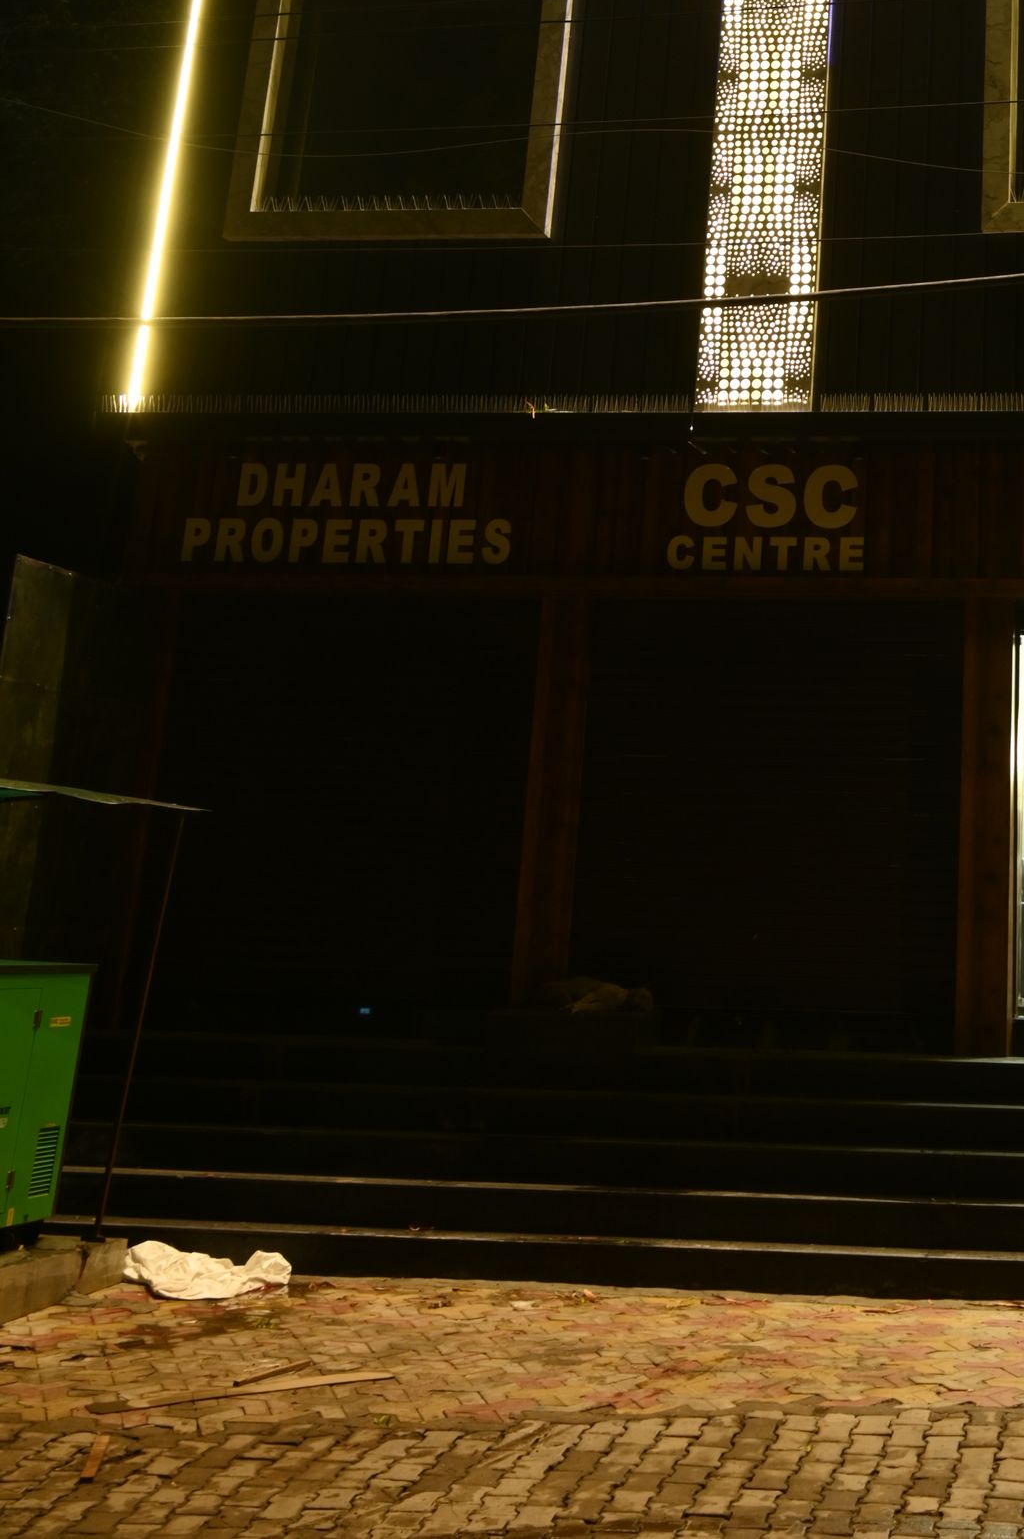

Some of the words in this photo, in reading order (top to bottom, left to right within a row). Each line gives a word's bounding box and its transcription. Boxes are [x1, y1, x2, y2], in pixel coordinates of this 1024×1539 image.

[236, 462, 468, 507] DHARAM
[683, 463, 860, 529] CSC
[180, 517, 512, 565] PROPERTIES
[665, 534, 865, 571] CENTRE
